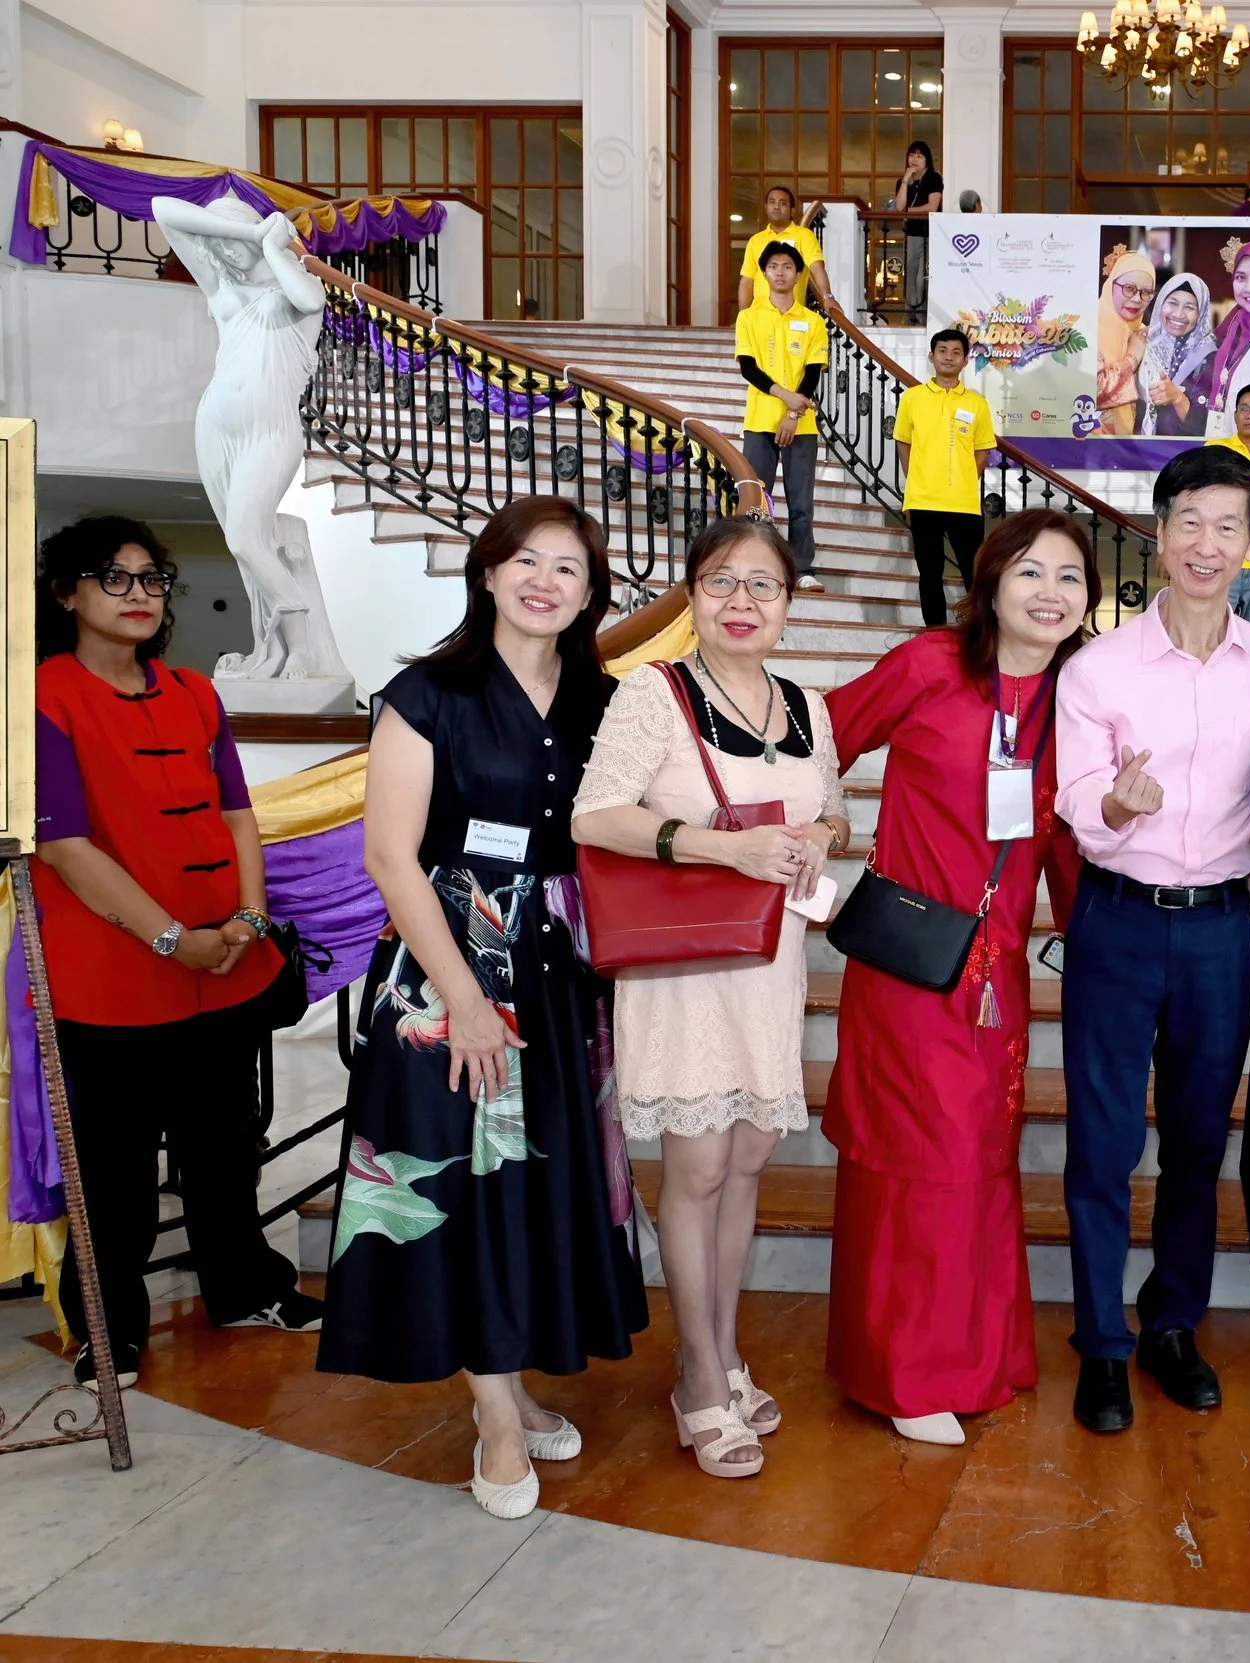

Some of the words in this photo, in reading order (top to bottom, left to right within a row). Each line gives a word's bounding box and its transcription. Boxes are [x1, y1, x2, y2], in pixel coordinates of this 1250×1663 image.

[988, 311, 1032, 324] Blossom
[956, 319, 1037, 345] Tribute
[984, 347, 1021, 358] Seniors
[504, 839, 519, 847] Party
